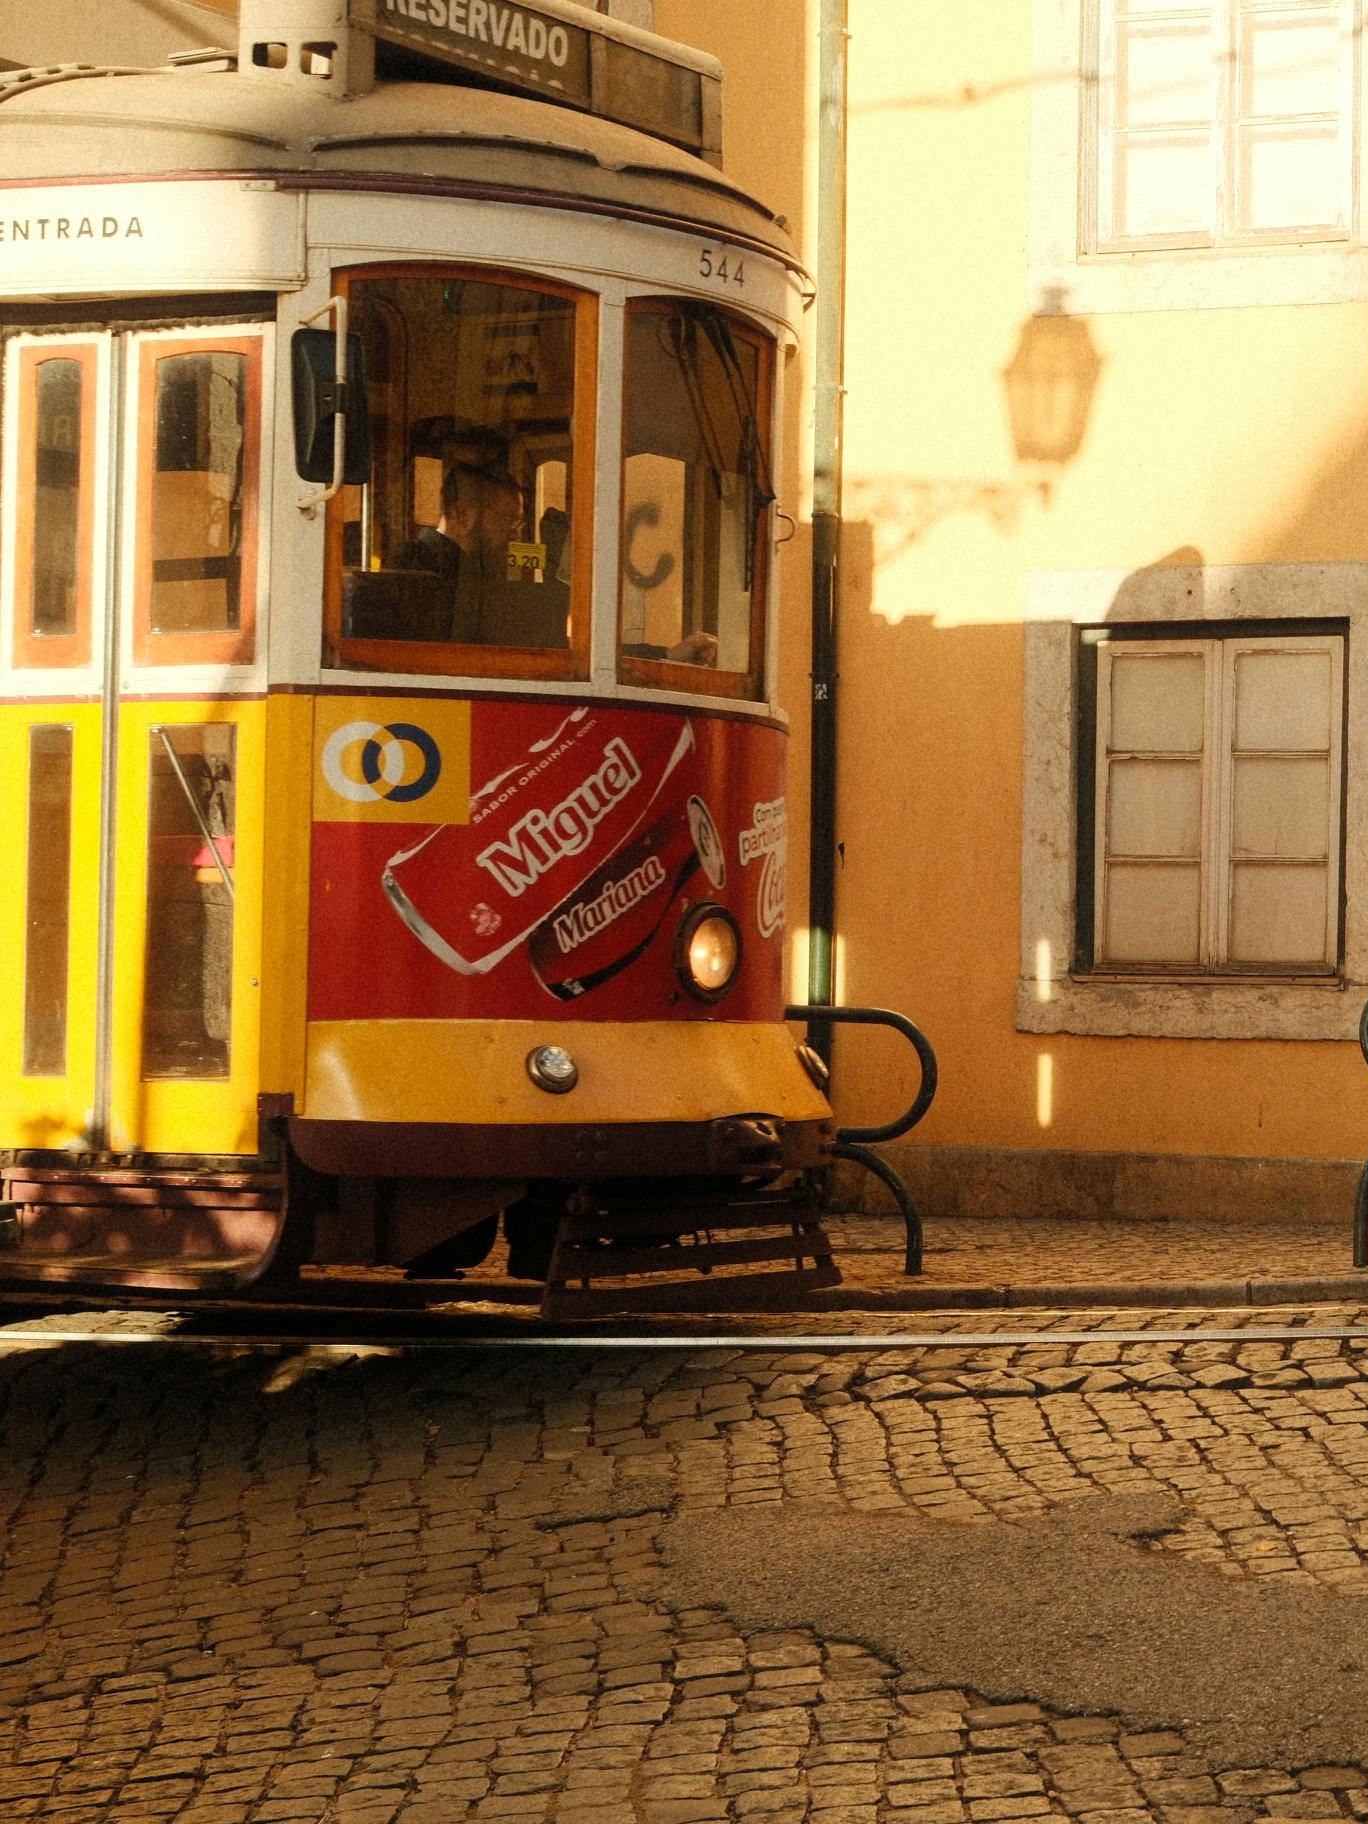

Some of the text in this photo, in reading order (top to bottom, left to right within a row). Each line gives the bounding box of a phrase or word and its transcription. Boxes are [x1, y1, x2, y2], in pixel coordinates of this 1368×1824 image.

[699, 249, 745, 288] 544
[508, 554, 540, 569] 3.20
[472, 786, 518, 824] SABOR
[518, 739, 577, 786] ORIGINAL
[476, 737, 641, 897] Miguel
[553, 856, 666, 954] Mariana
